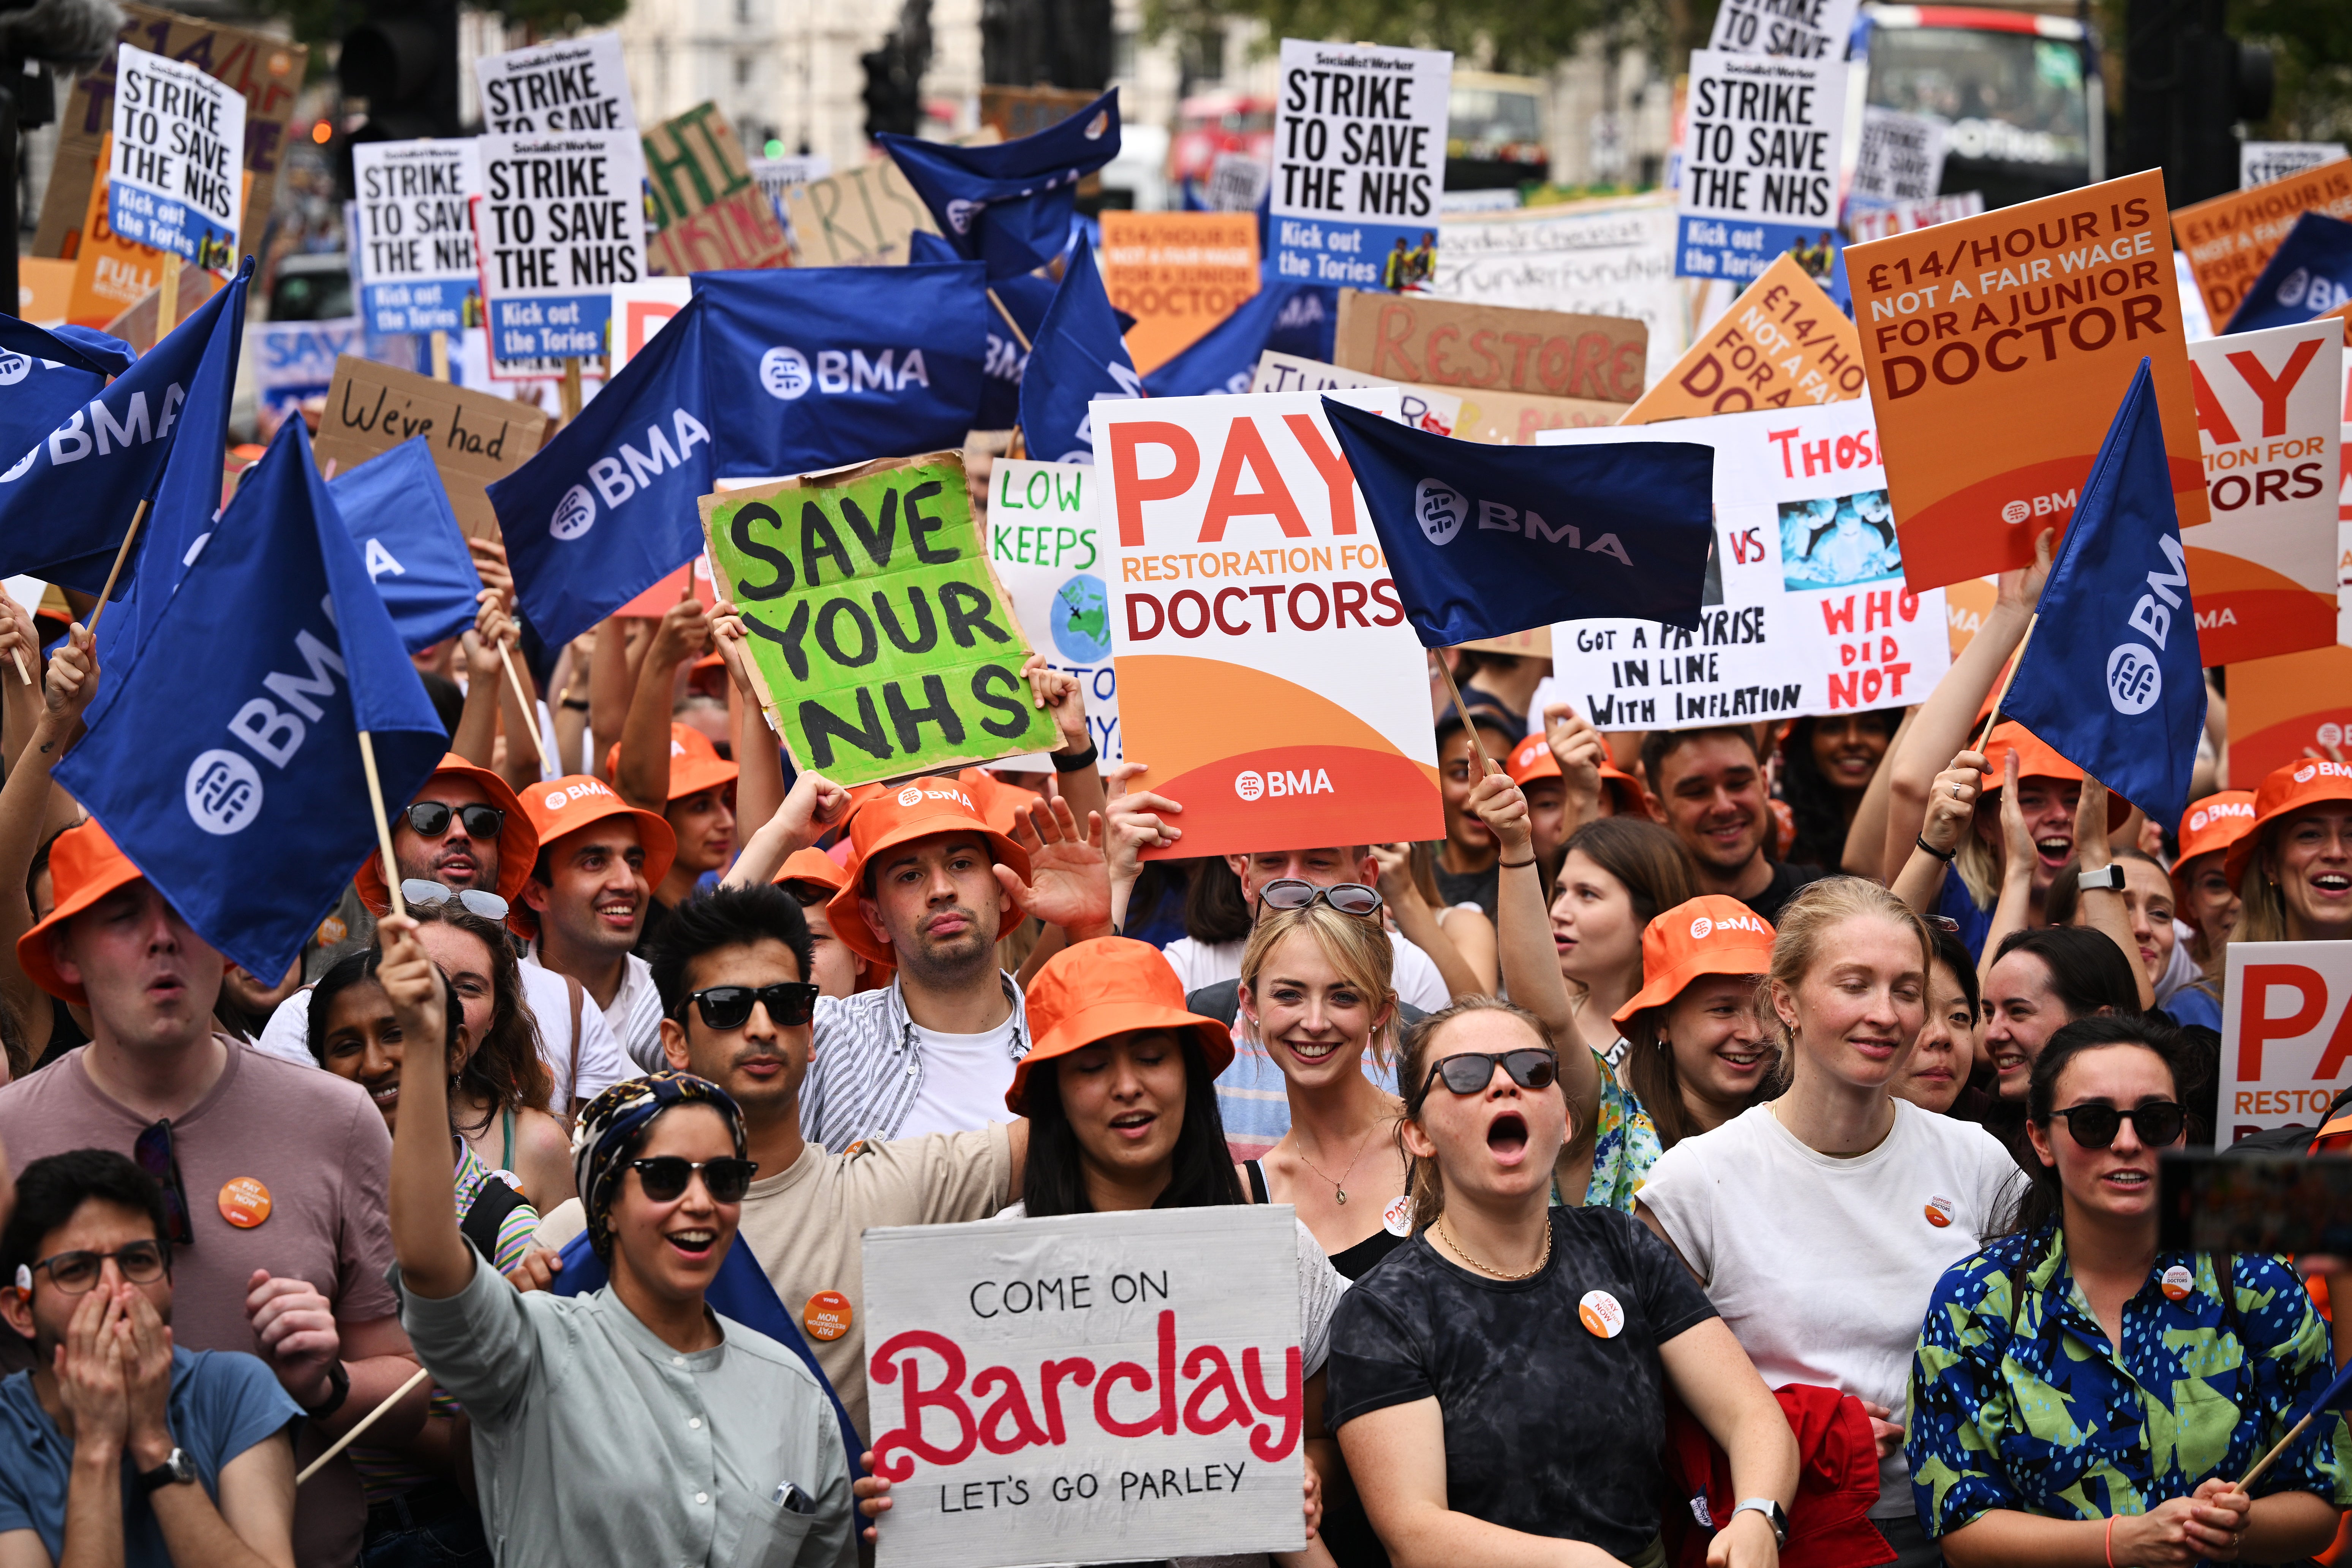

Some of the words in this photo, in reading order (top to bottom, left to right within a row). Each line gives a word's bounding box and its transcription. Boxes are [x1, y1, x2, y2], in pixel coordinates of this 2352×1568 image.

[1726, 8, 1758, 46] TO
[1315, 52, 1369, 68] Socialist
[1371, 59, 1415, 72] Worker
[125, 70, 221, 137] STRIKE
[488, 63, 601, 116] STRIKE
[1286, 68, 1414, 120] STRIKE
[1697, 77, 1816, 125] STRIKE
[122, 105, 158, 145] TO
[170, 123, 230, 180] SAVE
[513, 142, 563, 155] Socialist
[566, 141, 606, 152] Worker
[1284, 116, 1326, 162] TO
[1342, 122, 1430, 169] SAVE
[1693, 122, 1734, 163] TO
[1747, 127, 1830, 172] SAVE
[120, 142, 173, 189] THE
[185, 163, 231, 218] NHS
[365, 162, 464, 199] STRIKE
[490, 157, 609, 201] STRIKE
[1281, 164, 1347, 211] THE
[1359, 171, 1432, 217] NHS
[1690, 167, 1750, 210] THE
[1762, 174, 1830, 217] NHS
[117, 187, 154, 216] Kick
[158, 206, 186, 227] out
[367, 203, 403, 236] TO
[492, 204, 534, 245] TO
[548, 201, 630, 243] SAVE
[117, 211, 144, 237] the
[148, 219, 194, 257] Tories
[1280, 221, 1324, 249] Kick
[1327, 229, 1363, 254] out
[1687, 220, 1728, 247] Kick
[1731, 227, 1765, 251] out
[1867, 212, 2099, 293] £14/HOUR
[2111, 198, 2150, 232] IS
[370, 240, 422, 273] THE
[435, 238, 476, 270] NH
[494, 248, 558, 289] THE
[572, 245, 638, 285] NHS
[1279, 251, 1313, 277] the
[1317, 253, 1377, 283] Tories
[1685, 248, 1717, 273] the
[1871, 285, 1940, 321] NOT
[1949, 280, 1972, 303] A
[1979, 258, 2052, 295] FAIR
[2058, 231, 2154, 274] WAGE
[1876, 311, 1961, 354] FOR
[1971, 303, 2000, 331] A
[2008, 260, 2160, 327] JUNIOR
[2305, 274, 2350, 311] BM
[502, 303, 544, 326] Kick
[547, 303, 580, 325] out
[504, 331, 537, 354] the
[540, 329, 598, 352] Tories
[1372, 305, 1644, 399] RESTORE
[1739, 306, 1791, 356] NOT
[1780, 355, 1803, 378] A
[1798, 369, 1843, 404] FAI
[1763, 285, 1865, 392] £14/HO
[1881, 294, 2167, 400] DOCTOR
[816, 348, 929, 394] BMA
[1715, 327, 1774, 391] FOR
[1766, 388, 1792, 407] A
[2190, 338, 2325, 445] AY
[49, 382, 185, 466] BMA
[342, 379, 433, 440] We've
[448, 404, 508, 461] had
[587, 408, 711, 511] BMA
[2267, 436, 2324, 463] FOR
[1001, 470, 1082, 511] LOW
[1109, 410, 1383, 548] PAY
[2032, 488, 2077, 517] BM
[730, 481, 961, 601] SAVE
[994, 524, 1097, 570] KEEPS
[1478, 499, 1634, 566] BMA
[1730, 526, 1765, 565] VS
[1122, 546, 1332, 582] RESTORATION
[1341, 544, 1386, 571] FO
[1125, 578, 1405, 641] DOCTORS
[1821, 587, 1919, 635] WHO
[2128, 533, 2190, 651] BM
[741, 581, 1012, 682] YOUR
[1947, 603, 1981, 632] MA
[2194, 607, 2237, 631] MA
[1577, 629, 1617, 653] GOT
[1633, 627, 1647, 649] A
[1840, 635, 1898, 666] DID
[228, 594, 347, 770] BM
[1612, 660, 1649, 688] IN
[1660, 653, 1719, 685] LINE
[1828, 662, 1911, 710] NOT
[799, 664, 1030, 769] NHS
[1587, 694, 1655, 726] WITH
[1676, 684, 1802, 722] INFLATION
[1267, 767, 1334, 797] BMA
[2318, 762, 2352, 779] BM
[566, 782, 613, 801] BMA
[925, 787, 975, 812] BMA
[2208, 802, 2256, 824] BMA
[1716, 916, 1766, 935] BMA
[234, 1193, 258, 1208] NOW
[242, 1181, 261, 1194] PAY
[1931, 1202, 1951, 1212] DOCTORS
[1933, 1196, 1952, 1206] SUPPORT
[1385, 1197, 1408, 1224] PAY
[1397, 1214, 1413, 1231] DOCTO
[970, 1274, 1092, 1318] COME
[1111, 1270, 1168, 1304] ON
[1593, 1293, 1621, 1326] RESTORATION
[1595, 1303, 1613, 1322] NOW
[1605, 1297, 1619, 1312] PAY
[807, 1319, 846, 1330] RESTORATION
[817, 1312, 839, 1323] NOW
[817, 1327, 834, 1336] PAY
[1589, 1318, 1599, 1329] BMA
[869, 1308, 1304, 1483] Barclay
[940, 1474, 1030, 1513] LET'S
[1053, 1473, 1099, 1503] GO
[1121, 1461, 1245, 1501] PARLEY
